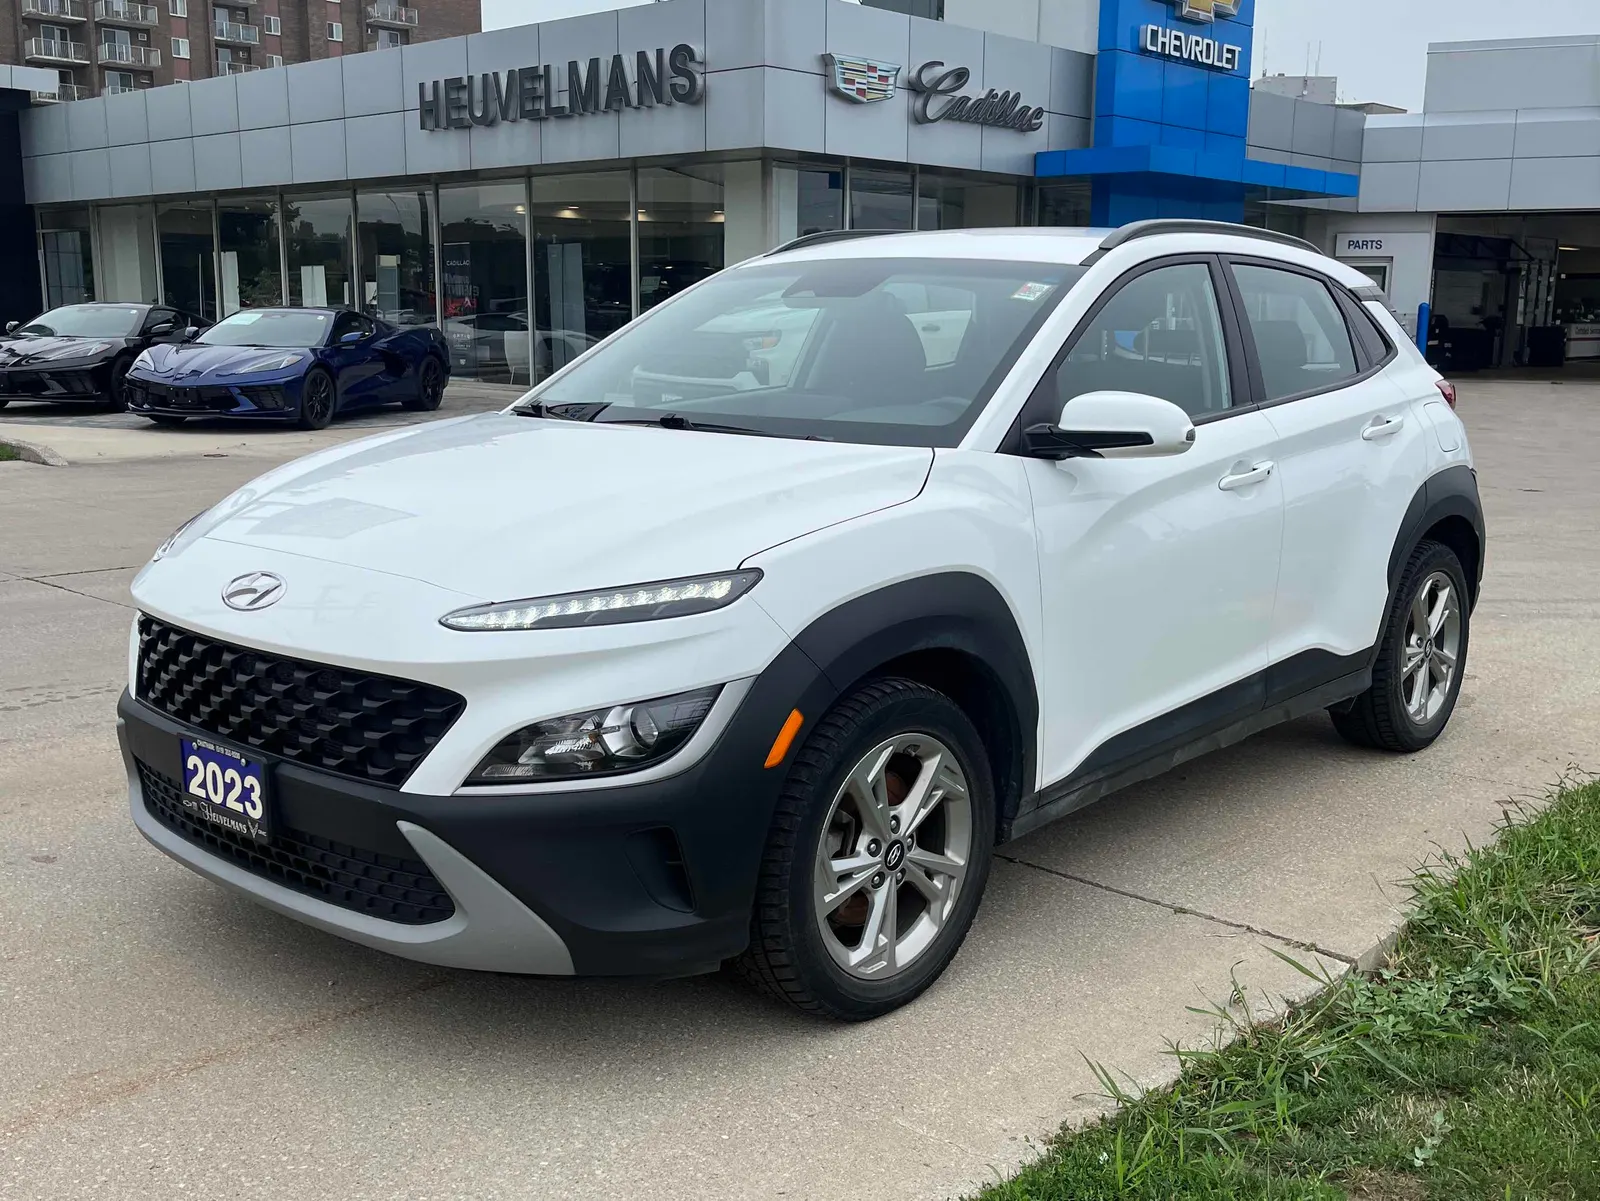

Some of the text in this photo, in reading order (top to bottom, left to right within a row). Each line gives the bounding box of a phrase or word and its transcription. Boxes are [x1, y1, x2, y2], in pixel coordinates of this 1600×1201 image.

[1140, 24, 1242, 71] CHEVROLET
[418, 43, 704, 131] HEUVELMANS
[908, 61, 1044, 132] Cadillac
[446, 259, 471, 267] CADILLAC
[1347, 239, 1384, 250] PARTS
[186, 755, 263, 819] 2023
[200, 801, 247, 834] HEUVELMANS
